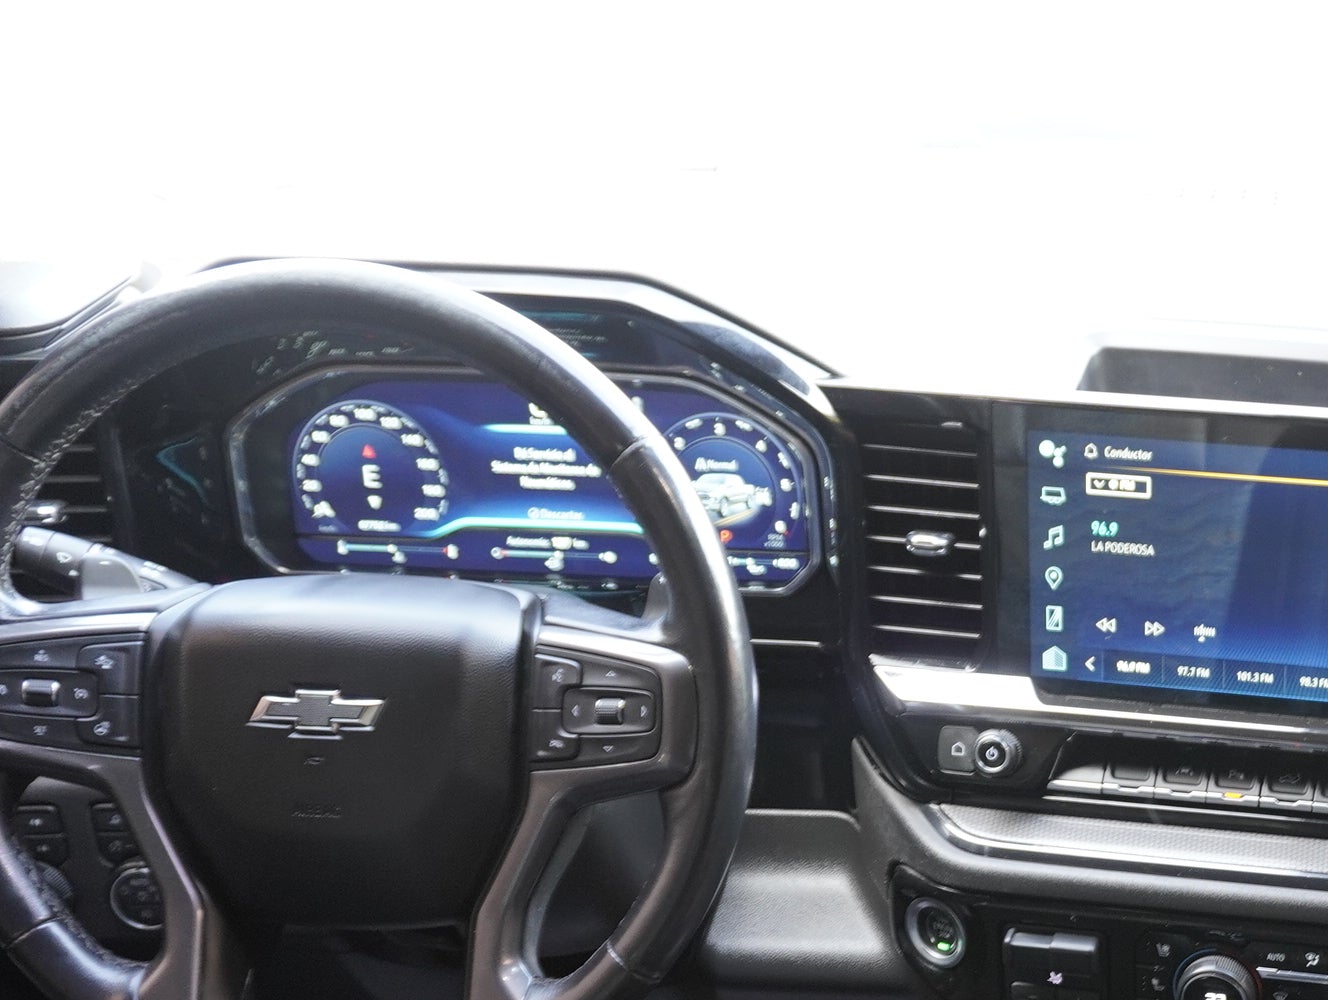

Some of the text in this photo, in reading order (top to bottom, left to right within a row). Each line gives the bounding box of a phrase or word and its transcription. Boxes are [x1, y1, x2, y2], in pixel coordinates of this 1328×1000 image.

[1104, 445, 1153, 462] Conductor
[362, 464, 383, 489] E
[1090, 520, 1119, 538] 96.9
[1091, 541, 1155, 556] LA PODEROSA
[1177, 665, 1210, 679] 97.7 FM
[1236, 670, 1274, 685] 101.3 FM
[1266, 952, 1285, 962] AUTO
